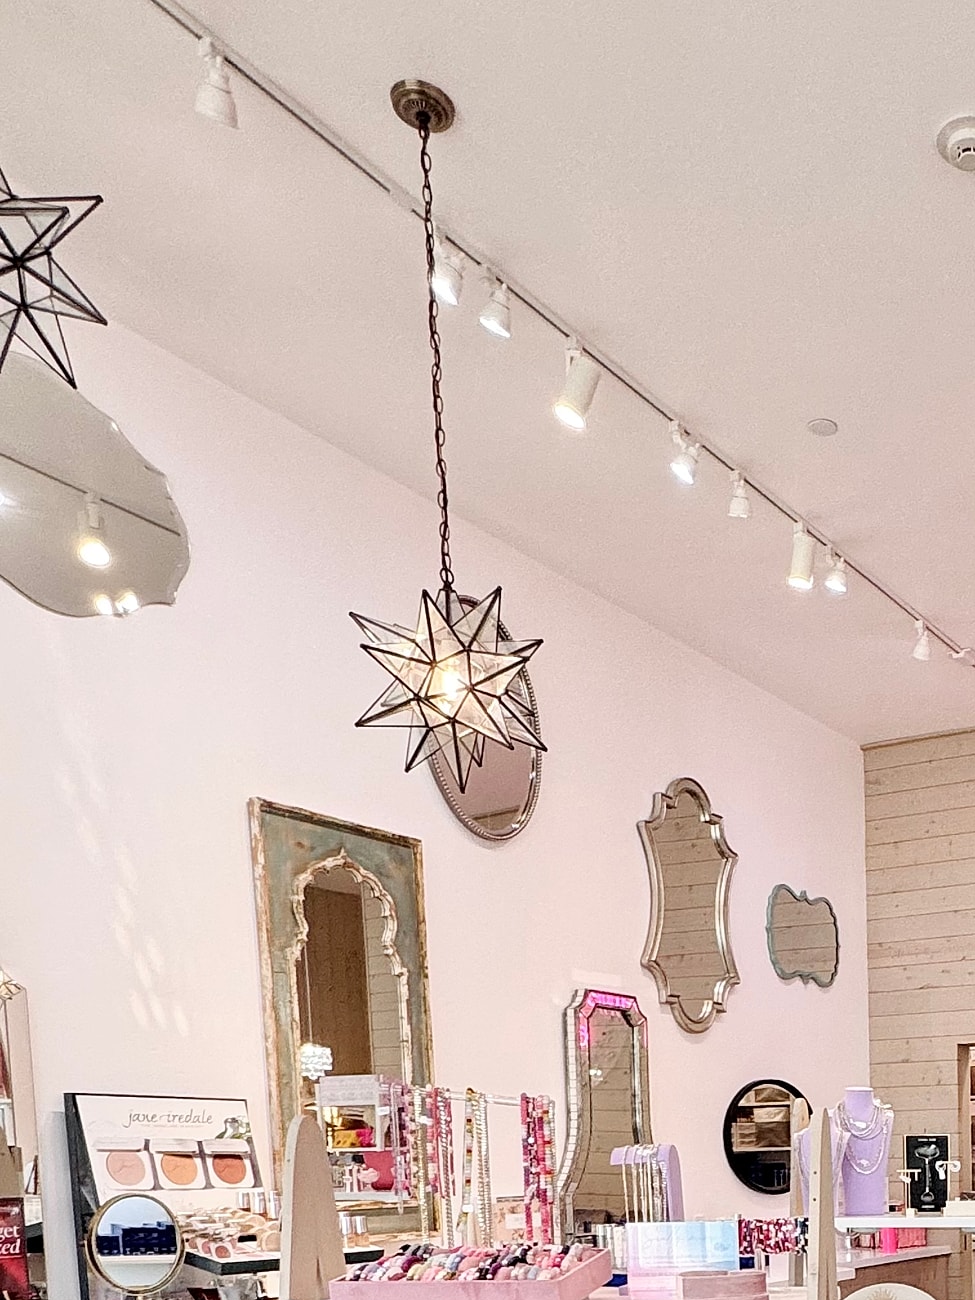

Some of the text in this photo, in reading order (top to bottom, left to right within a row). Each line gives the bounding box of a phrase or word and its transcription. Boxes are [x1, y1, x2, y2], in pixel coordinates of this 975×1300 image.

[122, 1109, 213, 1128] jane iredale
[0, 1239, 21, 1255] ed
